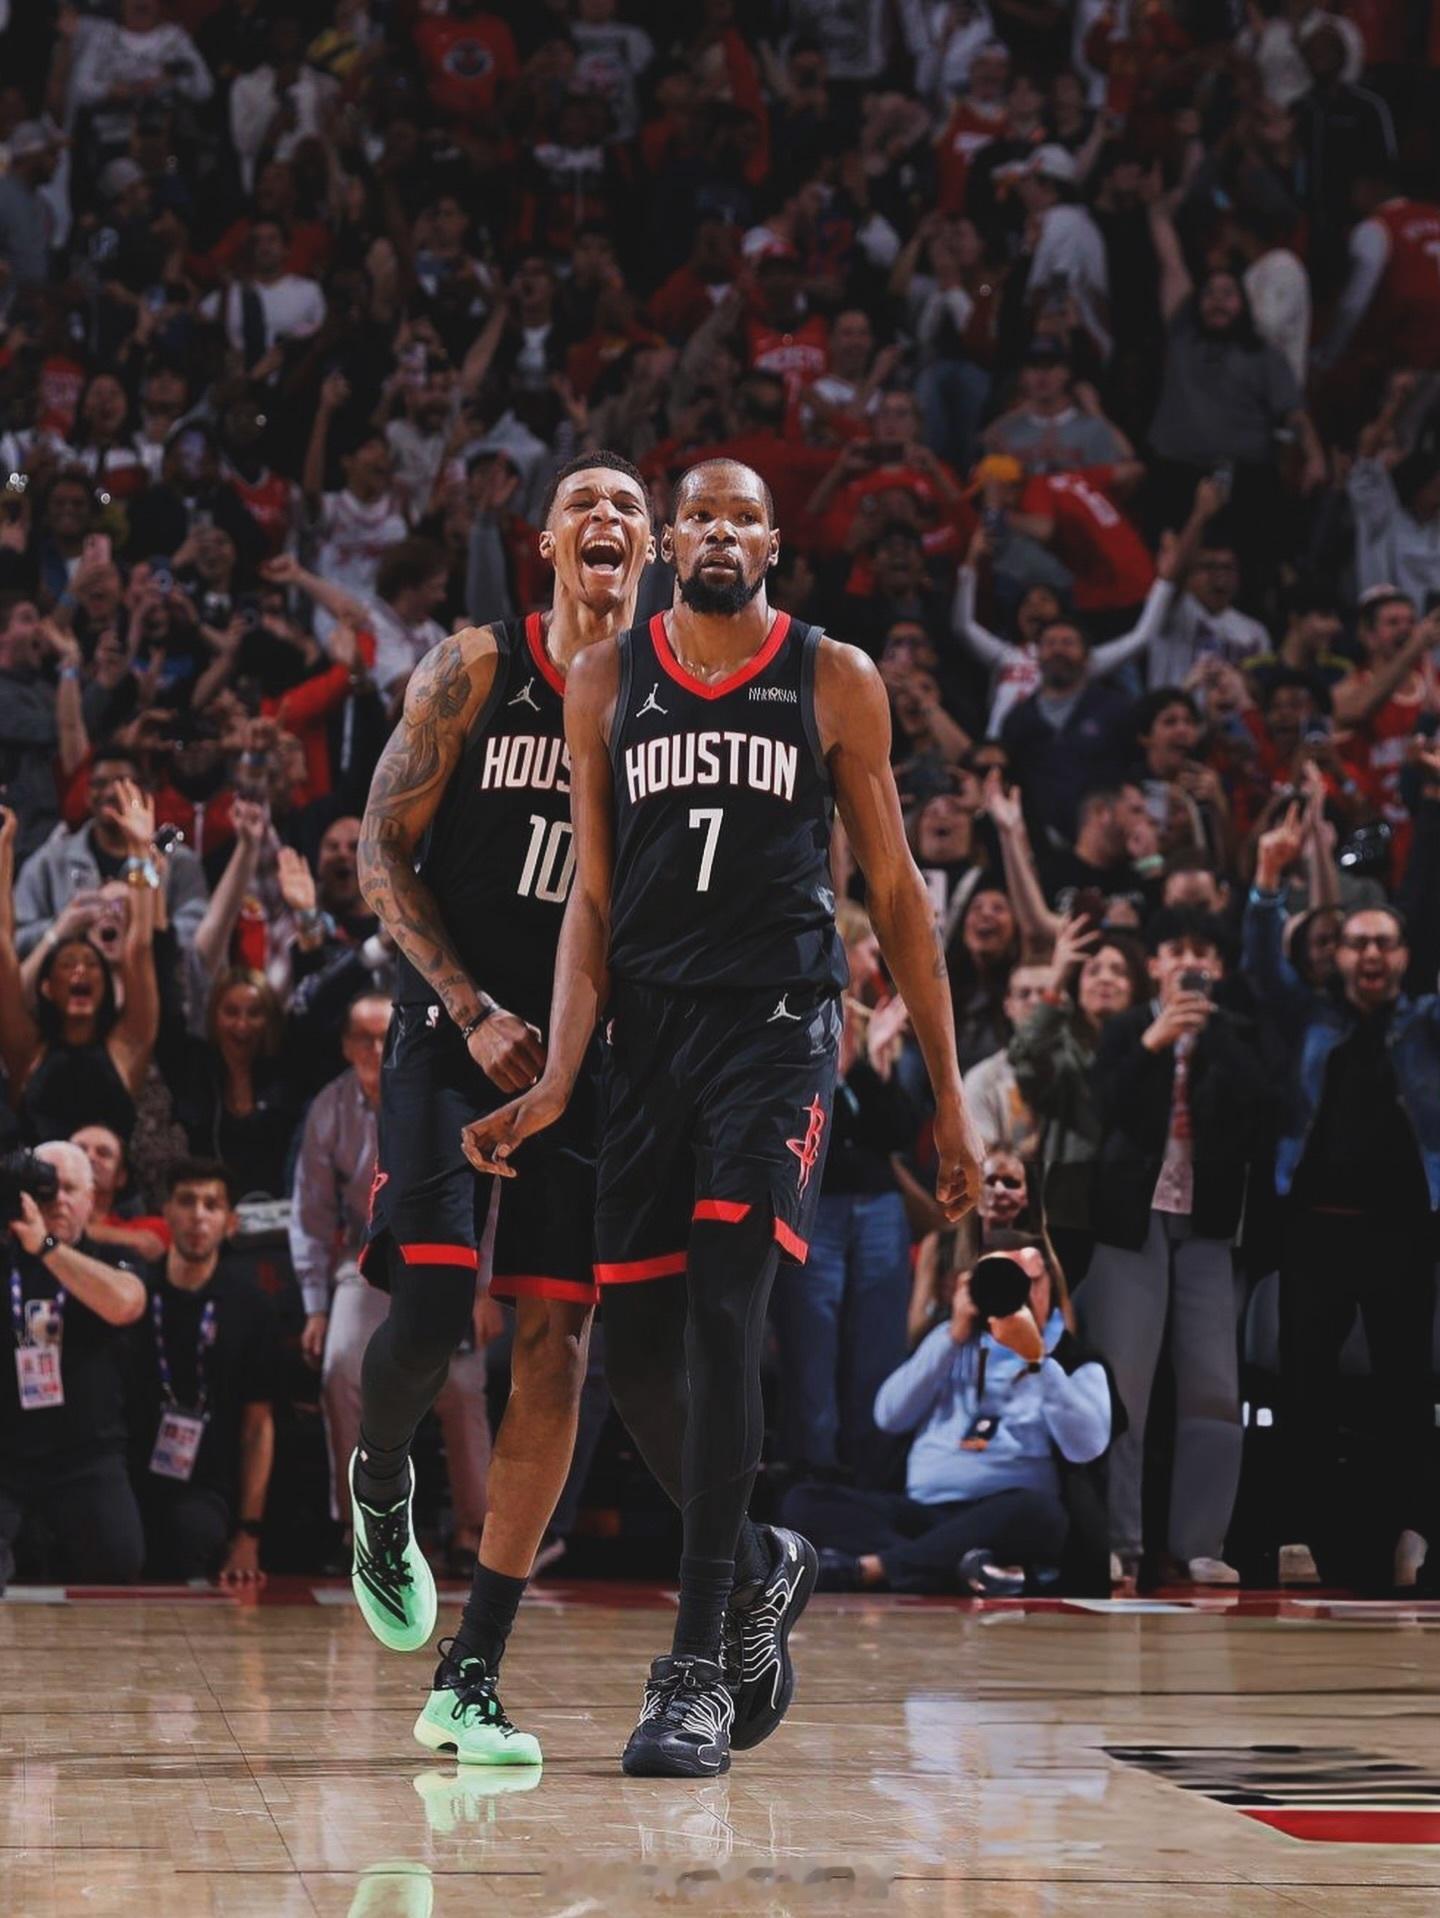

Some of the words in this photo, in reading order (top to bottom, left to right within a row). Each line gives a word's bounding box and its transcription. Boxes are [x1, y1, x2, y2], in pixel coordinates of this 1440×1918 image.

[625, 731, 798, 804] HOUSTON
[516, 813, 577, 903] 10
[688, 807, 724, 892] 7
